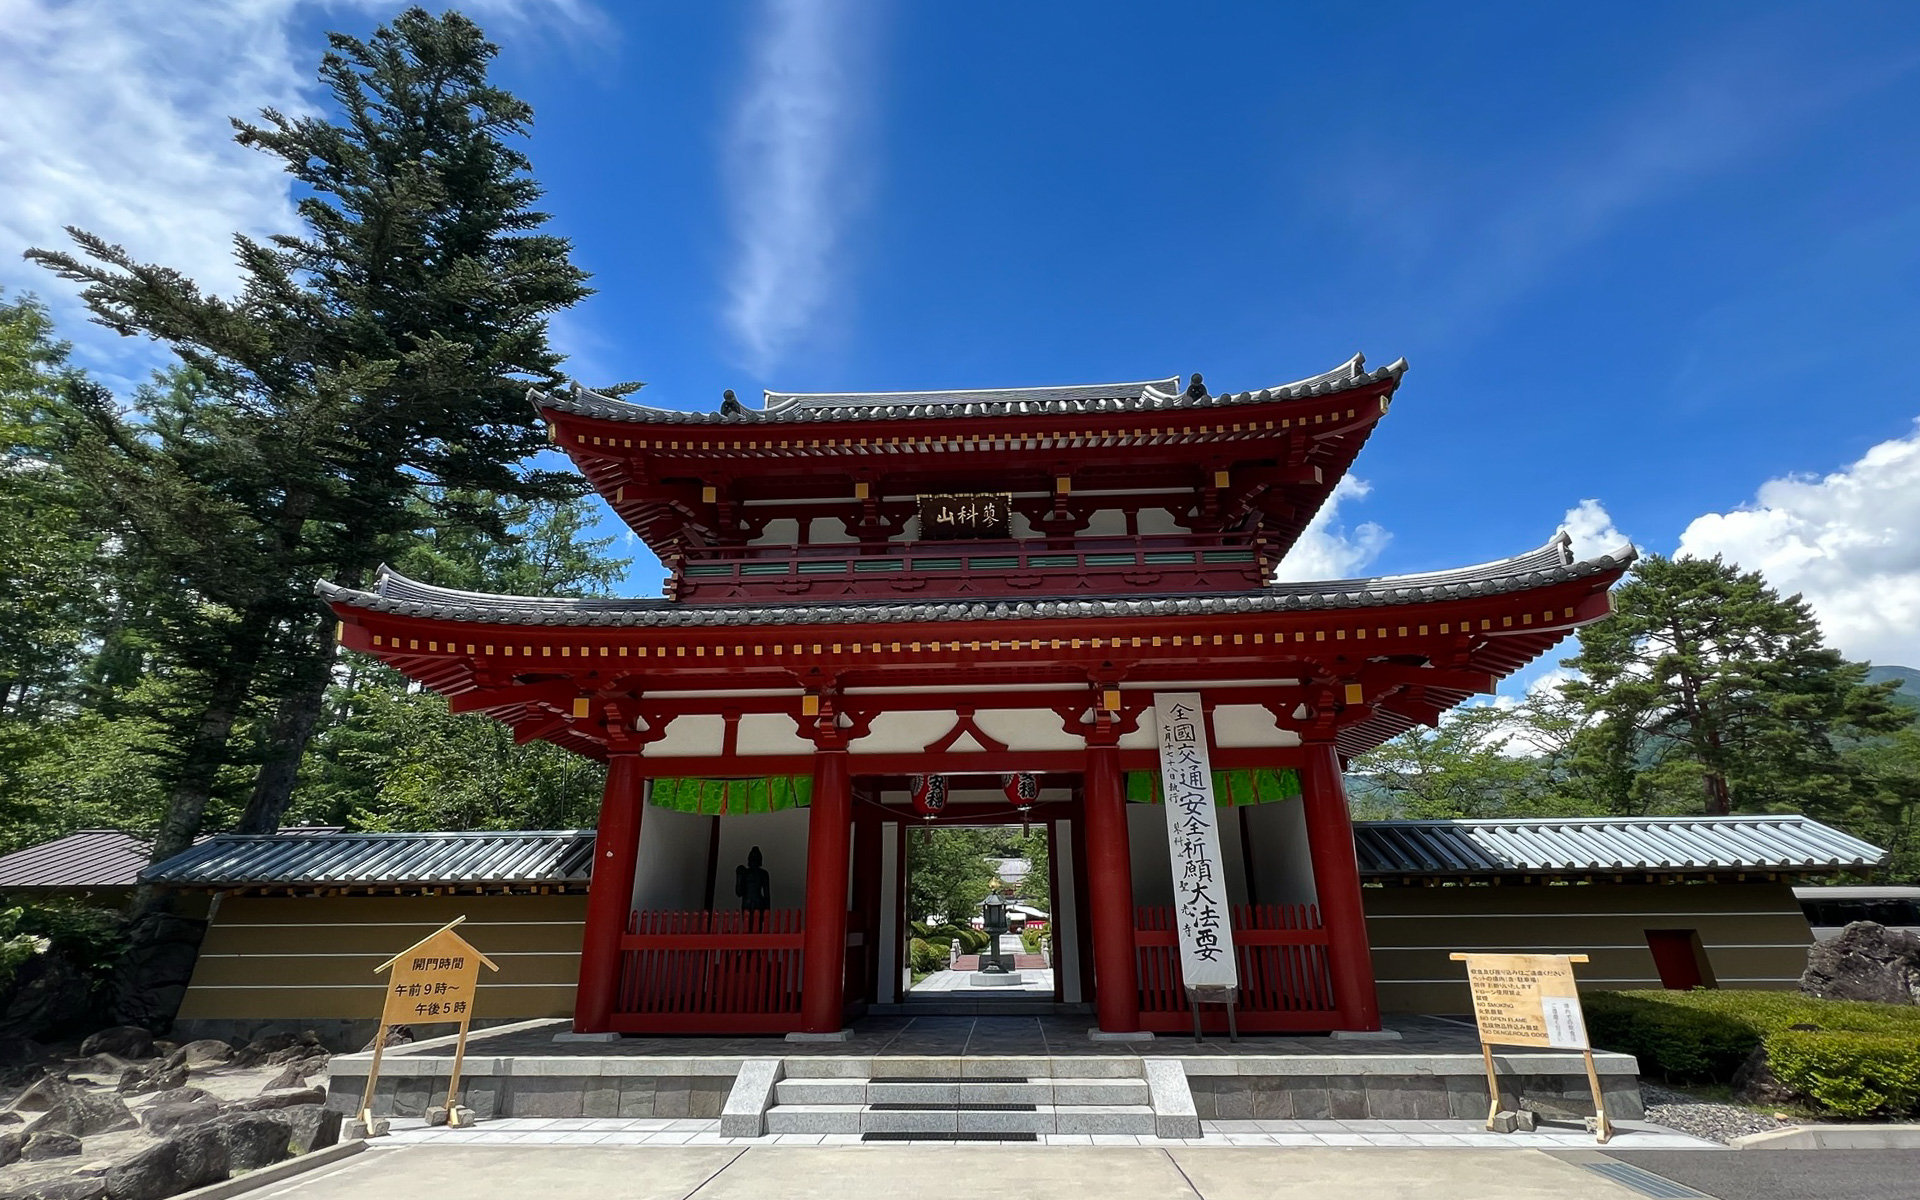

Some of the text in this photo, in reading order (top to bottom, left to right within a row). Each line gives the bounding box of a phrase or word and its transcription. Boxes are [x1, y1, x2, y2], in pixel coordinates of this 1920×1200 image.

[412, 957, 464, 971] 開門時間
[415, 1001, 467, 1016] 午後5時
